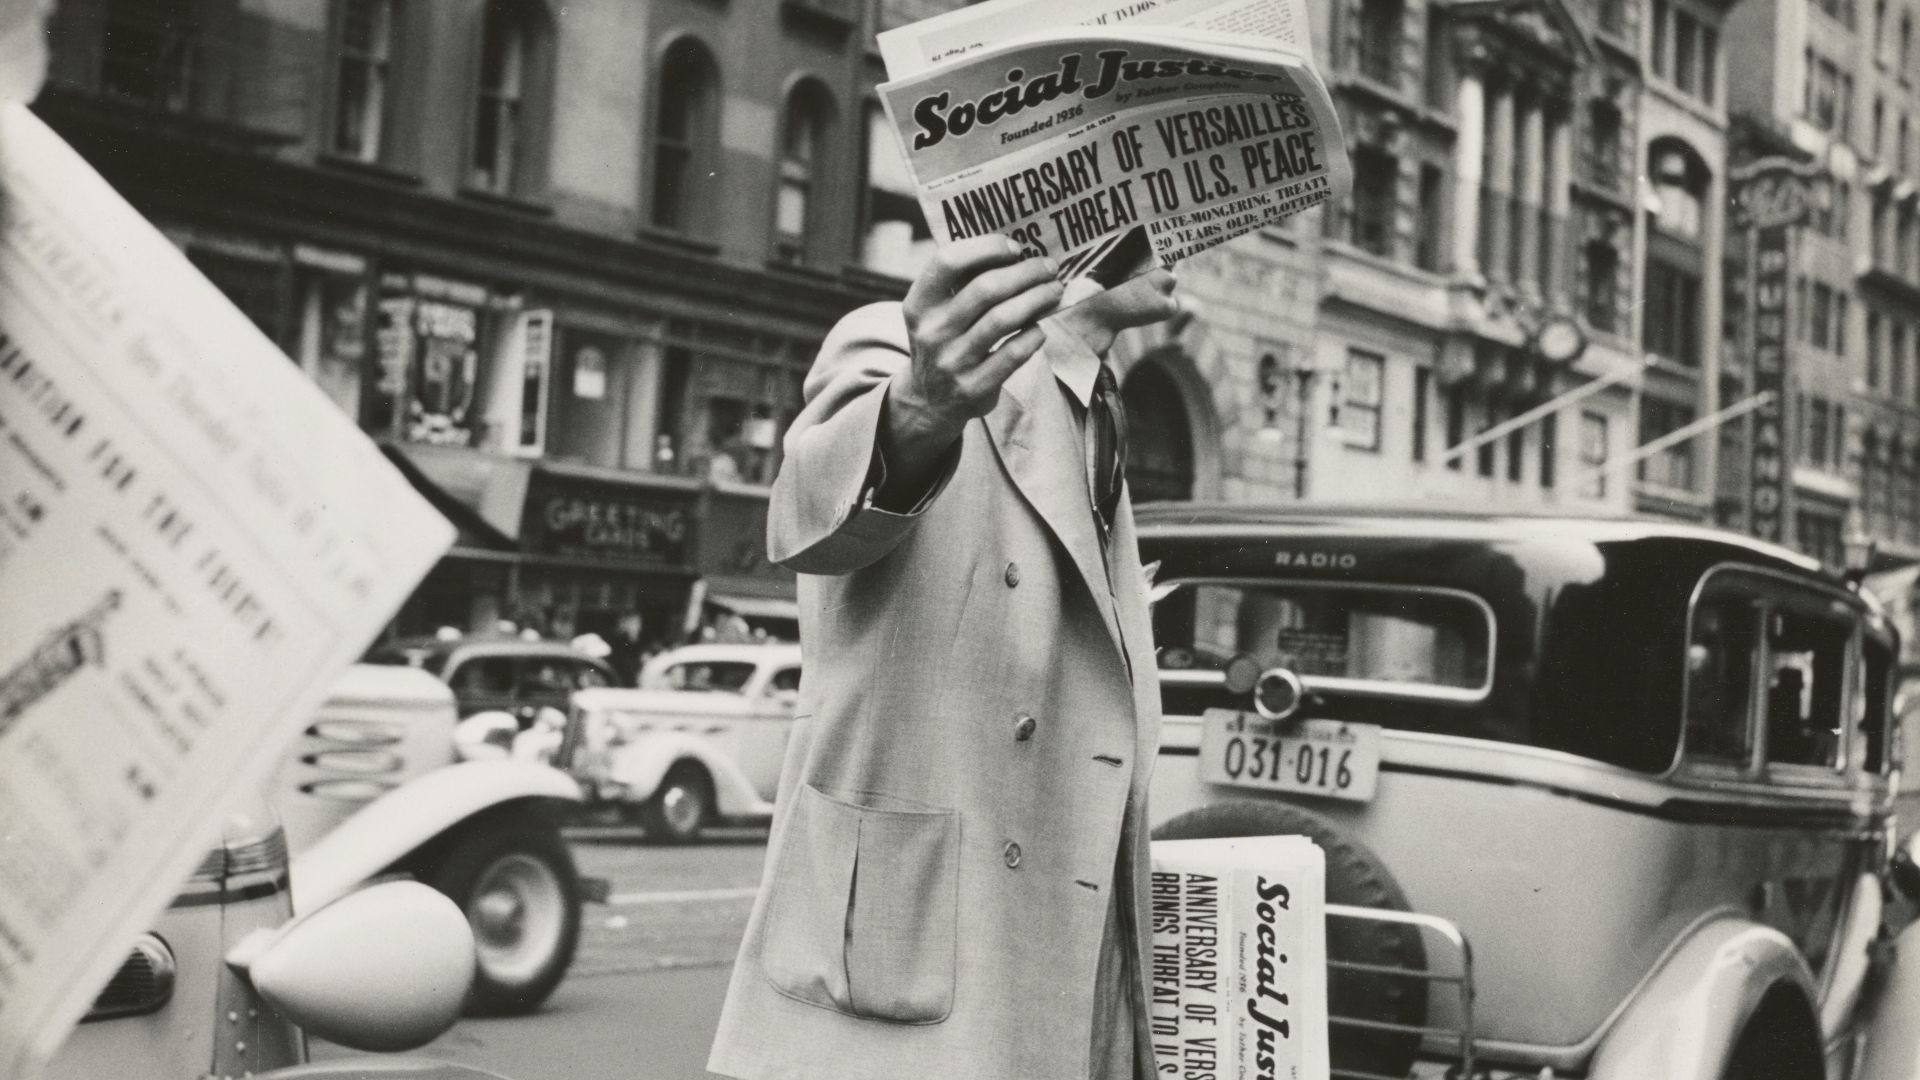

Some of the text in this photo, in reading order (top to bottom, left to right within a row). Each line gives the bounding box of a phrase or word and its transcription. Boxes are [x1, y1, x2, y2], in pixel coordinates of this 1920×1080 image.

[913, 50, 1284, 150] Social Justice
[1001, 115, 1053, 144] Founded
[1055, 104, 1084, 124] 1936
[1136, 85, 1179, 98] Father
[942, 141, 1102, 242] ANNIVERSARY
[1112, 124, 1144, 173] OF
[1155, 101, 1312, 160] VERSAILLES
[1049, 179, 1139, 253] THREAT
[1141, 167, 1180, 214] TO
[1184, 153, 1238, 204] U.S.
[1242, 132, 1322, 188] PEACE
[1276, 175, 1328, 201] TREATY
[1155, 236, 1172, 251] 20
[1176, 222, 1222, 243] YEARS
[1263, 188, 1332, 218] PLOTTERS
[545, 498, 685, 541] GREETING
[1275, 552, 1357, 568] RADIO
[1152, 872, 1180, 935] BRINGS
[1153, 943, 1180, 1008] THREAT
[1184, 873, 1218, 1080] ANNIVERSARY OF VERS
[1238, 931, 1248, 971] Founded
[1247, 876, 1290, 1080] Social Jus
[1152, 1015, 1179, 1037] TO
